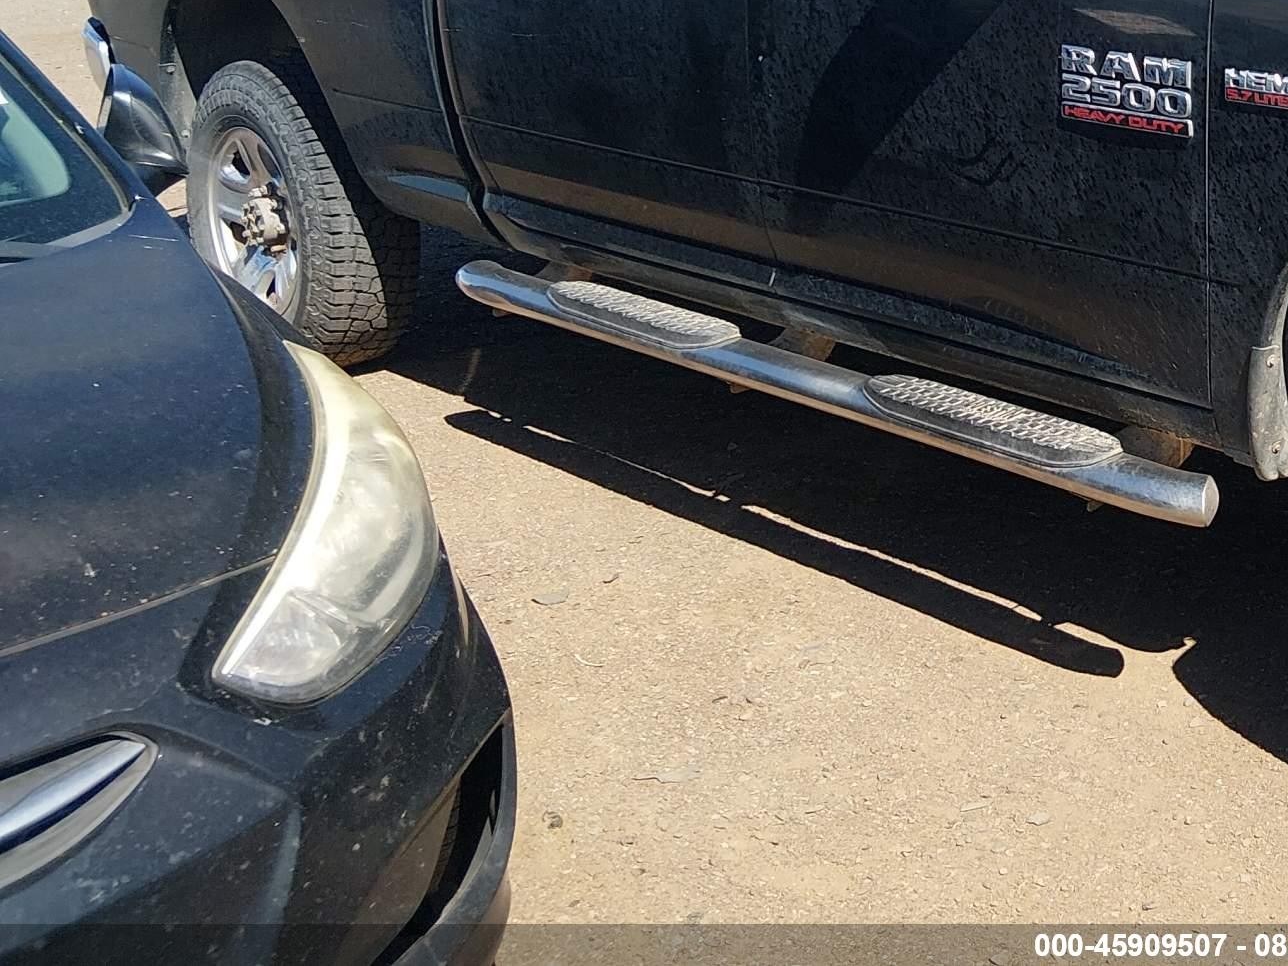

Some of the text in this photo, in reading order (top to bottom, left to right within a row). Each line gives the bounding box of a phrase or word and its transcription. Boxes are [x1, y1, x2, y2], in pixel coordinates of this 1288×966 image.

[1061, 44, 1192, 89] RAM
[1062, 73, 1192, 119] 2500
[1226, 88, 1252, 103] 5.7
[1064, 105, 1185, 134] HEAVY DUTY
